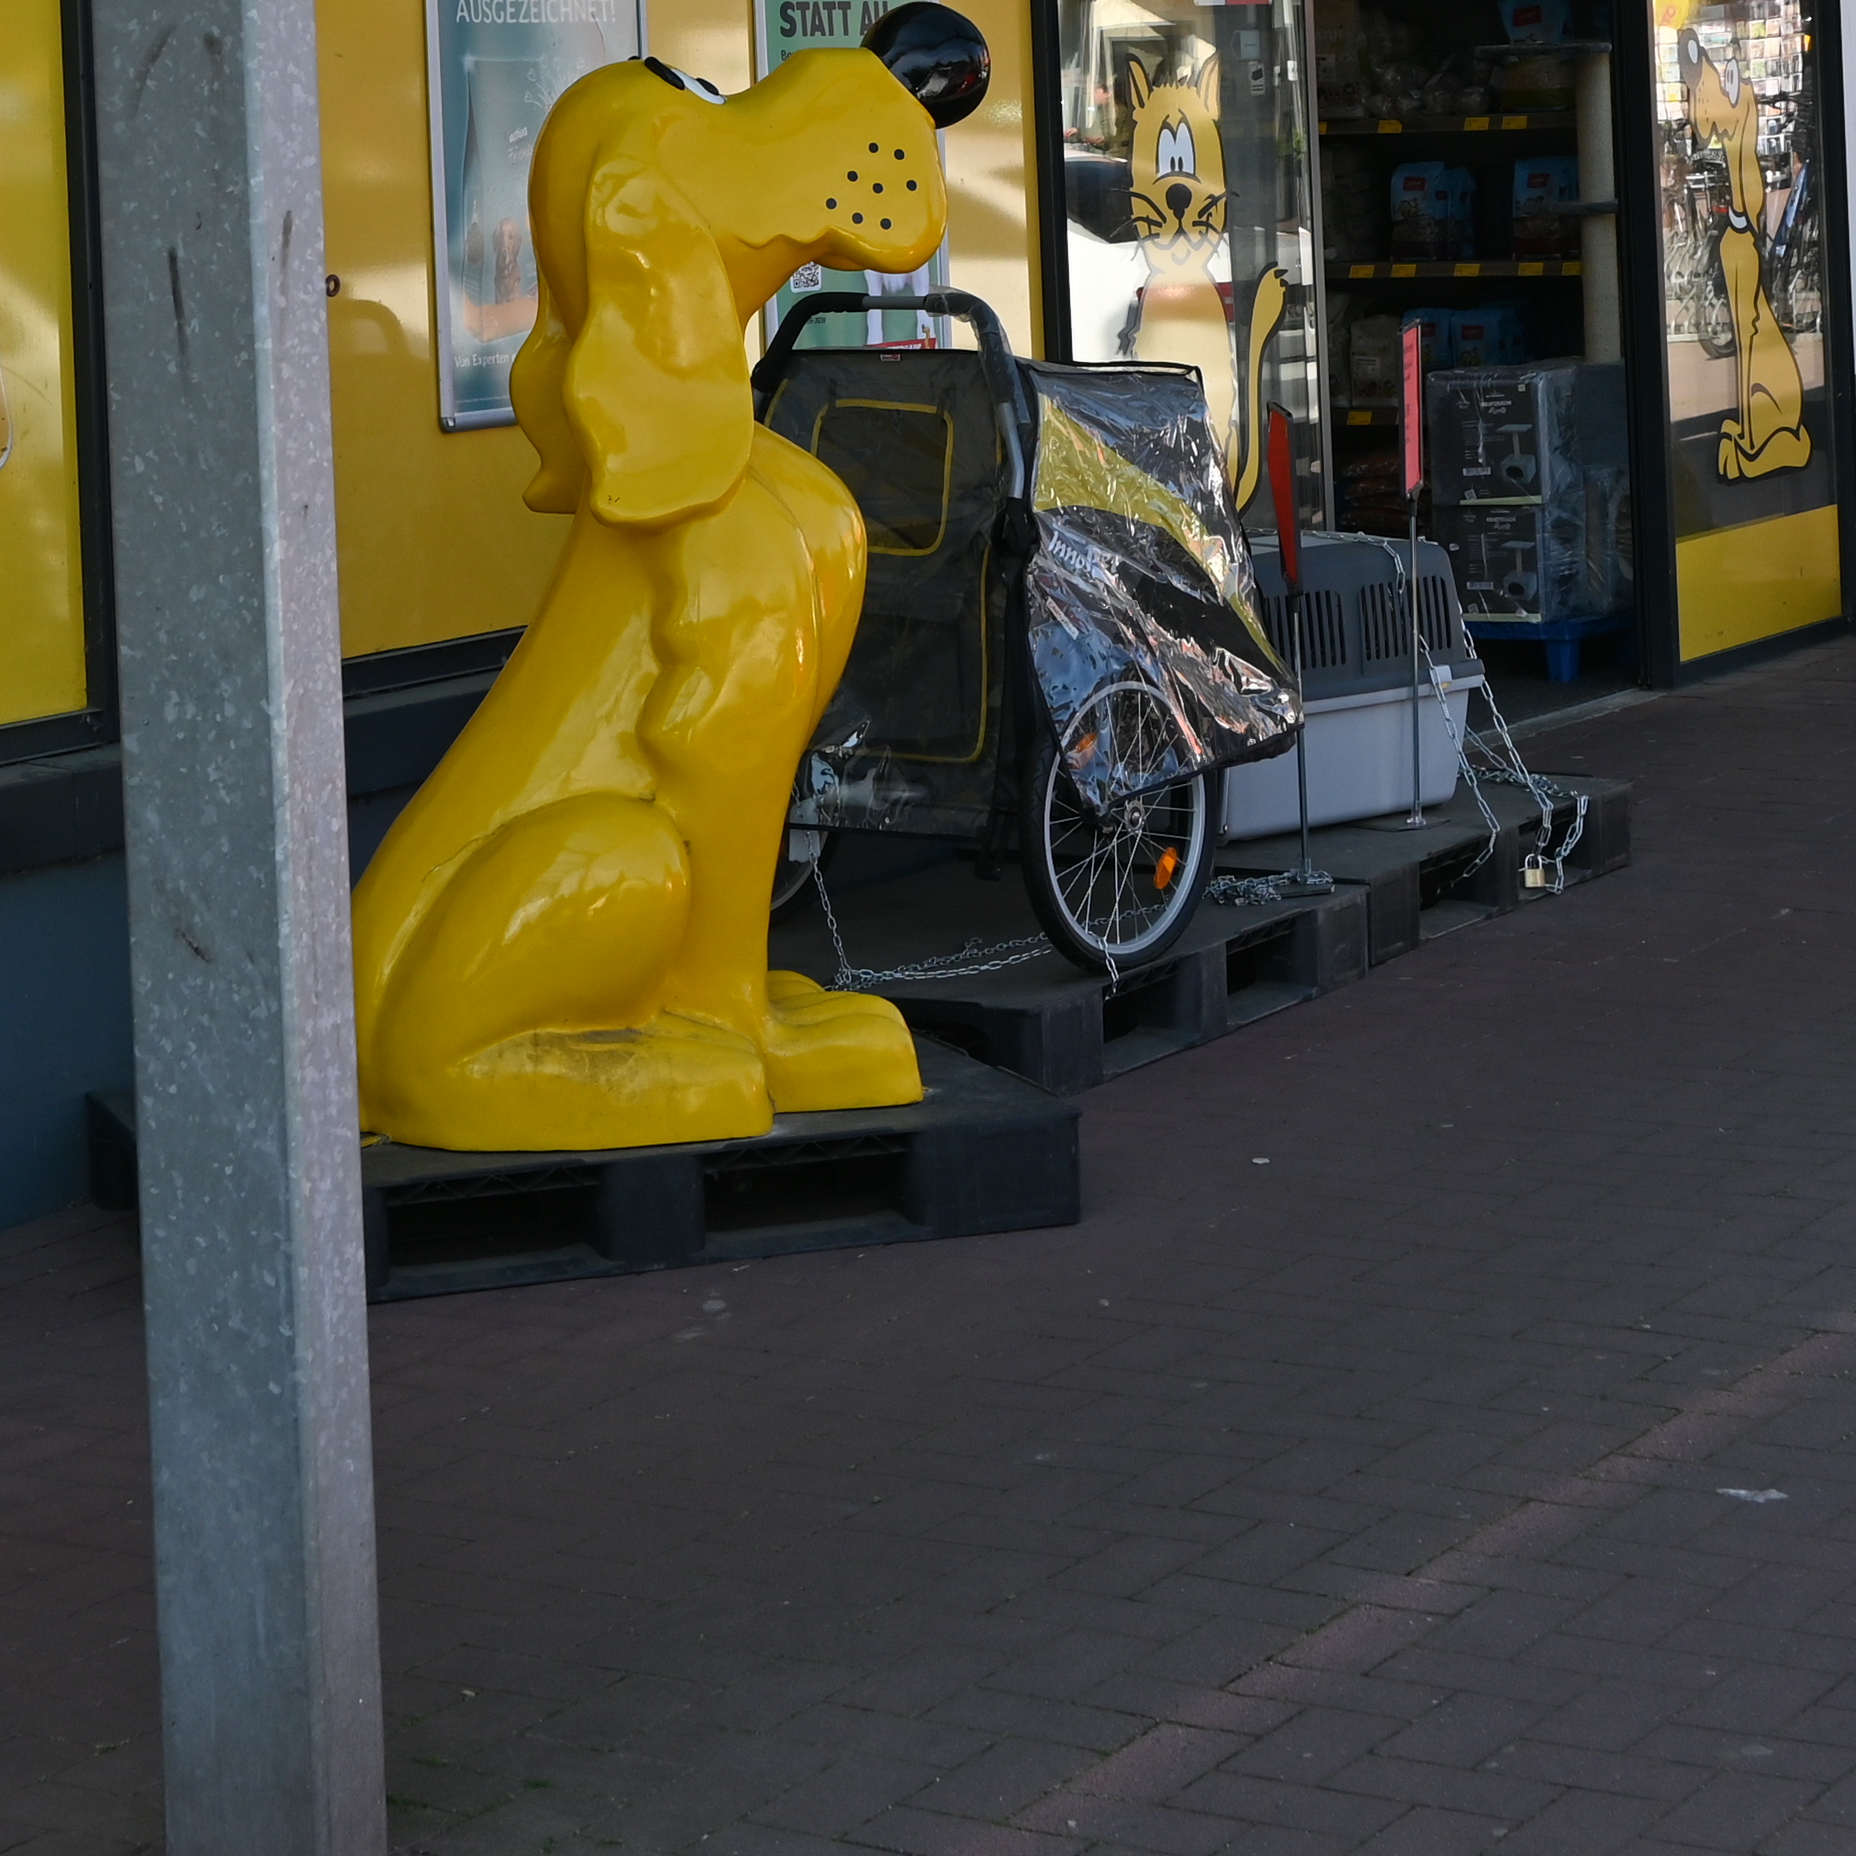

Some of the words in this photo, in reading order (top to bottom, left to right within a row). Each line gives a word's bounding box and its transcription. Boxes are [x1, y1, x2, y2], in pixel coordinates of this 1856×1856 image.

[779, 0, 851, 38] STATT
[454, 355, 470, 368] Von
[472, 353, 509, 367] Experten
